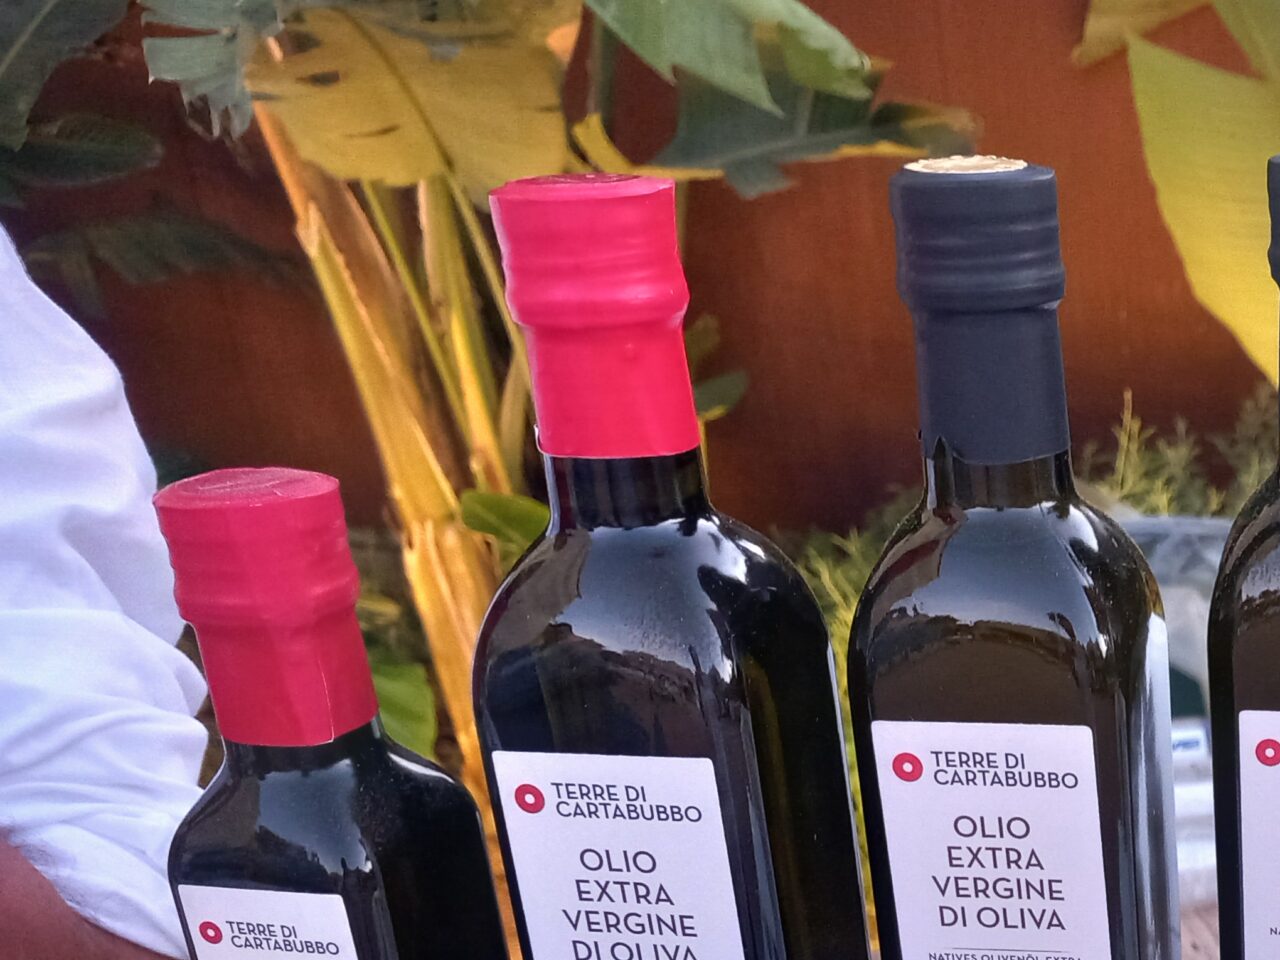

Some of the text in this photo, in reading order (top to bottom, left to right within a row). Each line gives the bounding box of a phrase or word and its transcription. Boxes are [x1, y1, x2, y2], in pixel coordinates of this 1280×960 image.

[930, 750, 1025, 770] TERRE DI
[934, 769, 1079, 789] CARTABUBBO
[550, 782, 647, 802] TERRE DI
[556, 801, 702, 823] CARTABUBBO
[953, 815, 1030, 839] OLIO
[579, 848, 657, 874] OLIO
[947, 845, 1045, 870] EXTRA
[575, 879, 675, 906] EXTRA
[932, 875, 1065, 901] VERGINE
[225, 920, 298, 939] TERRE DI
[562, 909, 698, 938] VERGINE
[938, 905, 1066, 931] DI OLIVA
[231, 935, 340, 955] CARTABUBBO
